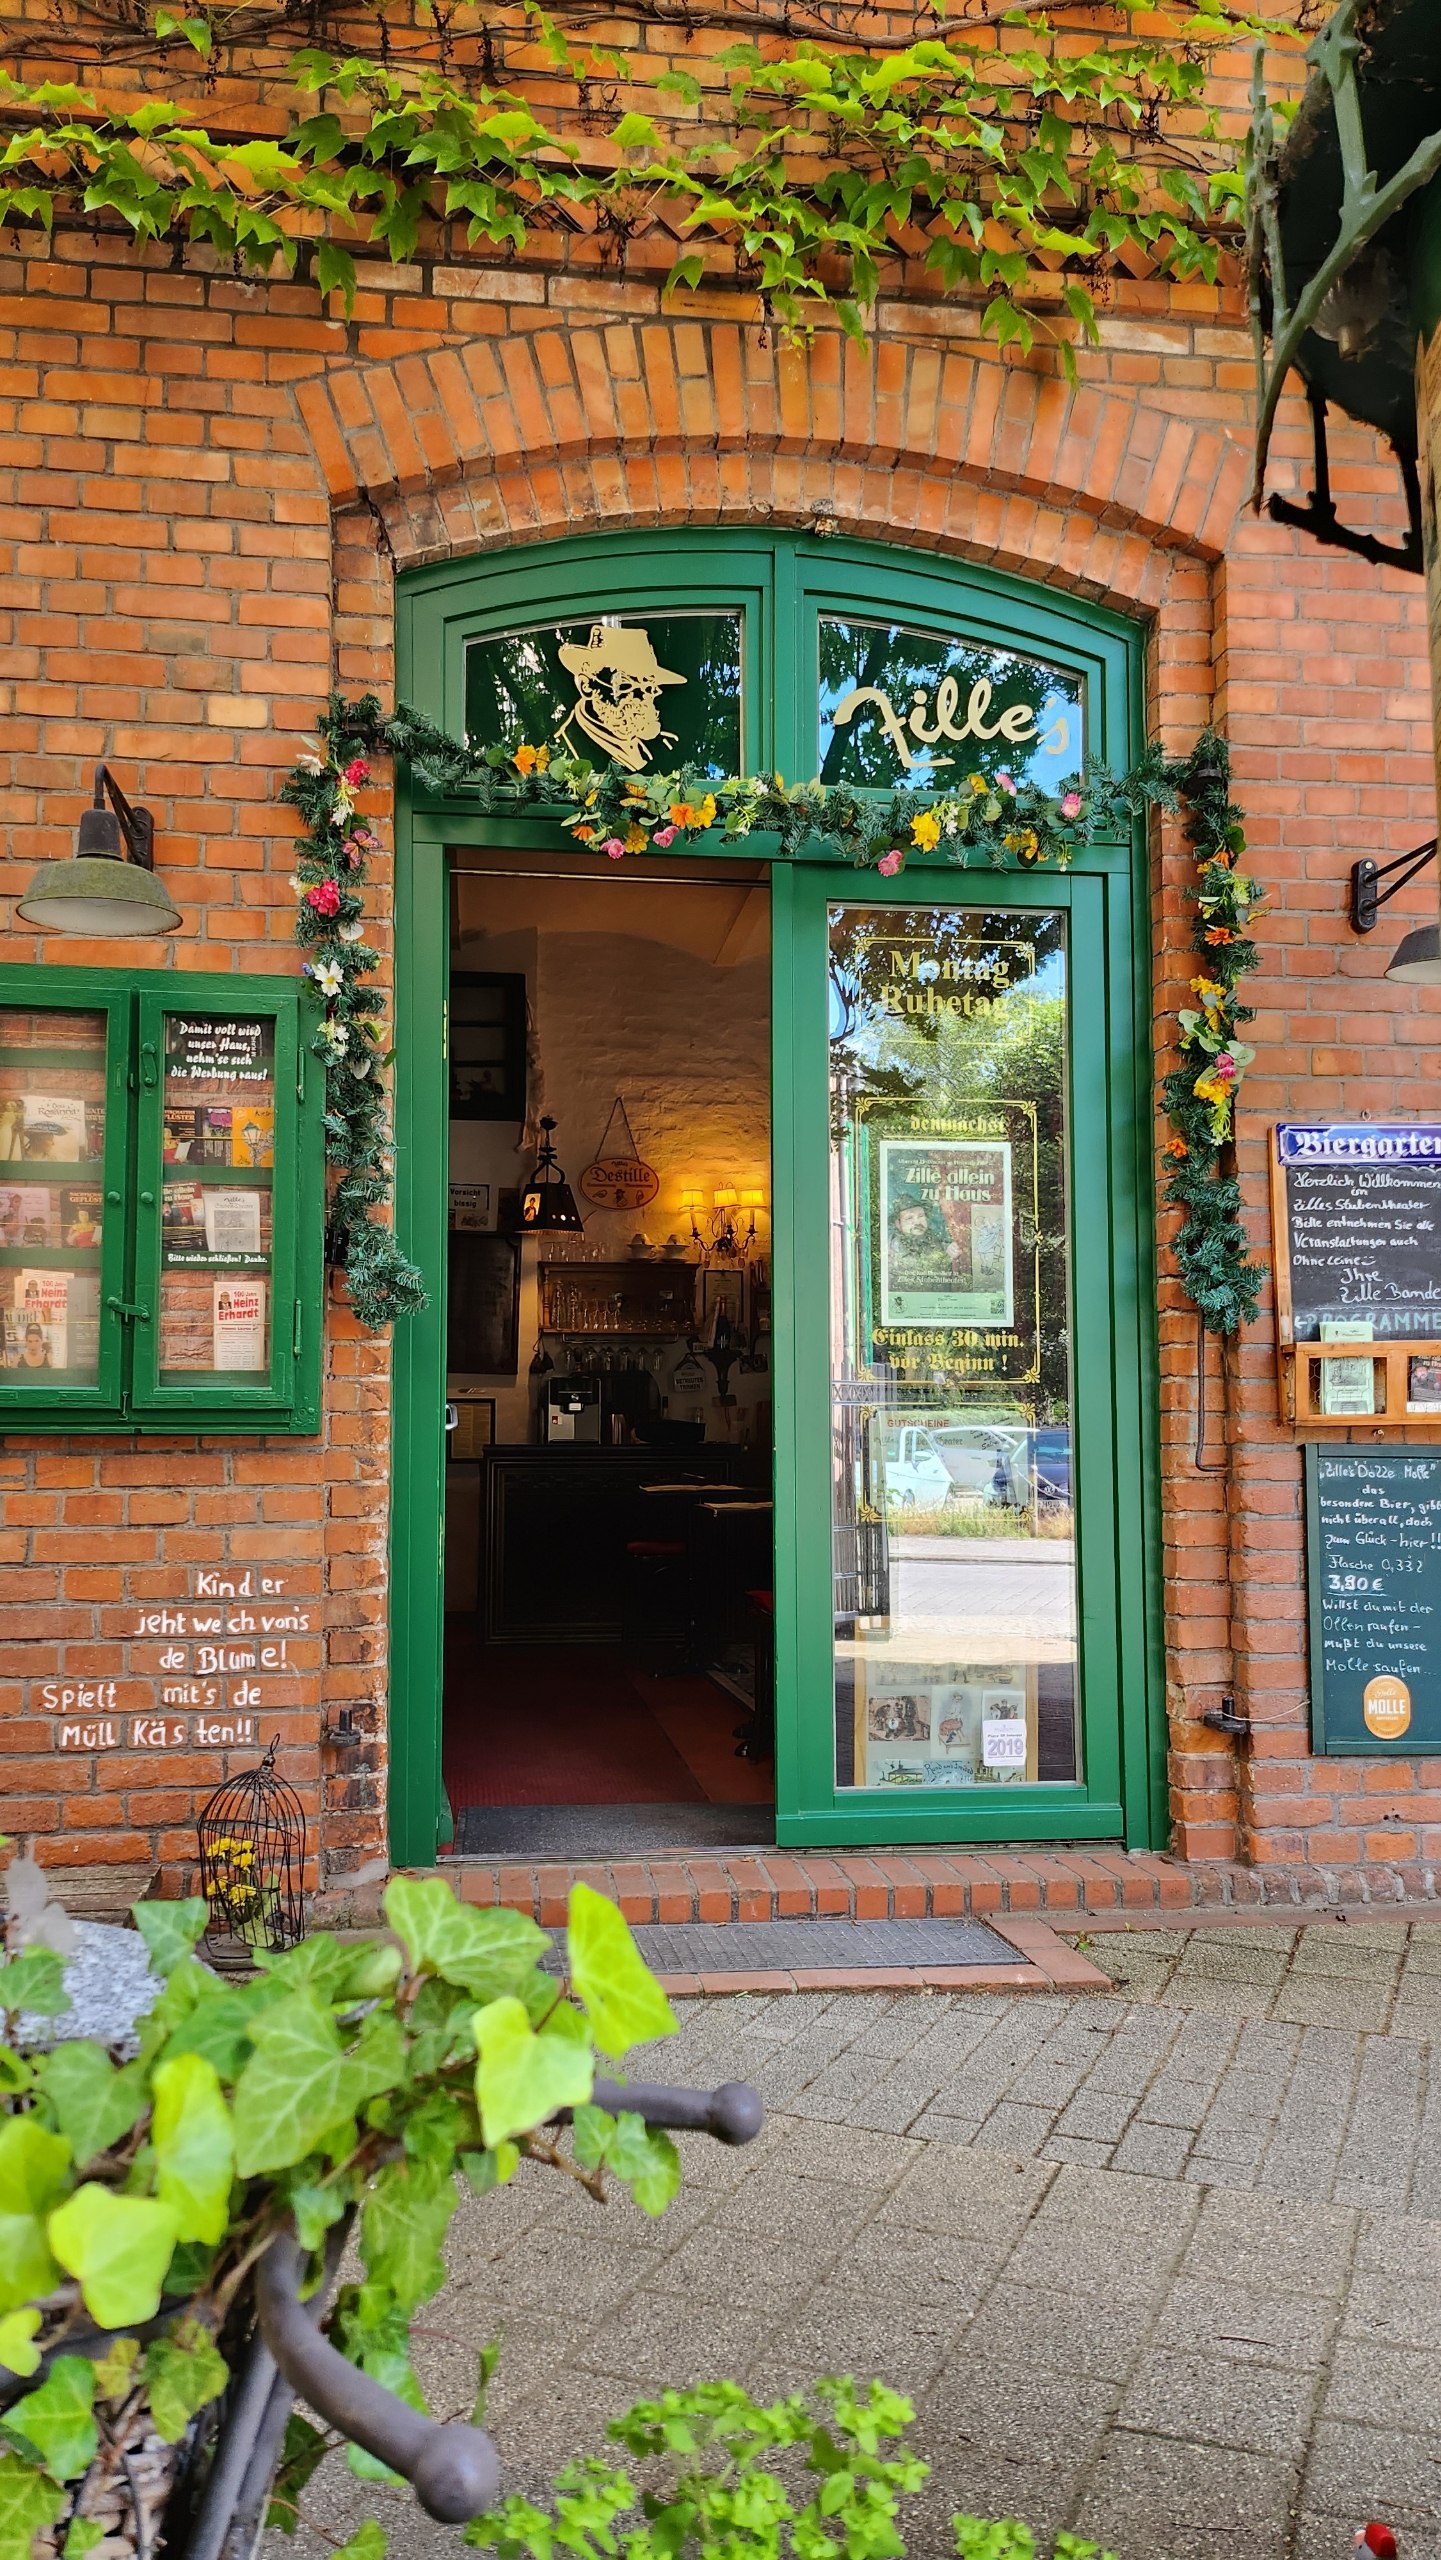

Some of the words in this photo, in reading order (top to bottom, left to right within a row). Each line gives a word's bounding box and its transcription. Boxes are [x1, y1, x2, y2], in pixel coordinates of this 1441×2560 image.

[889, 950, 1010, 988] Montag
[880, 985, 1009, 1025] Ruhetag
[179, 1021, 212, 1035] Damit
[214, 1023, 236, 1036] voll
[238, 1025, 261, 1036] wird
[187, 1041, 217, 1050] unser
[219, 1037, 251, 1052] Haus,
[231, 1053, 253, 1065] sich
[171, 1065, 188, 1077] die
[190, 1065, 237, 1081] Werbung
[239, 1068, 268, 1081] raus!
[590, 1167, 650, 1182] Destille
[904, 1168, 942, 1184] Zille
[947, 1168, 995, 1185] allein
[1293, 1172, 1354, 1188] Herzlich
[1358, 1172, 1441, 1189] Willkommen
[450, 1188, 481, 1196] Vorsicht
[920, 1188, 940, 1200] zu
[945, 1185, 992, 1201] Haus
[454, 1200, 476, 1208] bissig
[1293, 1197, 1333, 1211] Zilles
[1291, 1216, 1322, 1228] Bitte
[1327, 1216, 1391, 1229] entnehmen
[1395, 1219, 1412, 1230] Sie
[1416, 1220, 1435, 1231] alle
[1390, 1236, 1418, 1246] auch
[168, 1253, 185, 1262] Bitte
[186, 1254, 207, 1262] wieder
[208, 1254, 241, 1263] schließen!
[1293, 1254, 1324, 1266] Ohne
[1327, 1256, 1361, 1266] Leine
[41, 1288, 67, 1297] Heinz
[1339, 1283, 1382, 1304] Zille
[1384, 1280, 1441, 1300] Bande
[25, 1300, 67, 1308] Erhardt
[234, 1297, 259, 1308] Heinz
[218, 1308, 259, 1320] Erhardt
[872, 1329, 945, 1346] Einlass
[952, 1330, 978, 1347] 30
[984, 1330, 1025, 1347] min.
[889, 1353, 920, 1369] vor
[927, 1353, 995, 1376] Beginn
[1362, 1484, 1385, 1494] das
[1320, 1497, 1375, 1508] besondere
[1380, 1499, 1414, 1514] Bier,
[1321, 1514, 1351, 1524] nicht
[1356, 1531, 1387, 1545] Glück
[1328, 1554, 1373, 1571] Flasche
[1322, 1599, 1359, 1610] Willst
[1364, 1602, 1381, 1613] du
[1383, 1601, 1406, 1613] mit
[1410, 1602, 1434, 1613] der
[134, 1609, 186, 1635] jeht
[1323, 1616, 1363, 1631] Ollen
[1367, 1619, 1408, 1634] raufen
[1366, 1638, 1384, 1648] du
[1388, 1642, 1427, 1651] unsere
[159, 1647, 186, 1670] de
[1325, 1657, 1368, 1671] Molle
[42, 1683, 117, 1711] Spielt
[162, 1680, 217, 1706] mit's
[232, 1680, 262, 1706] de
[1368, 1699, 1406, 1715] MOLLE
[61, 1720, 116, 1747] Müll
[987, 1737, 1024, 1756] 2019
